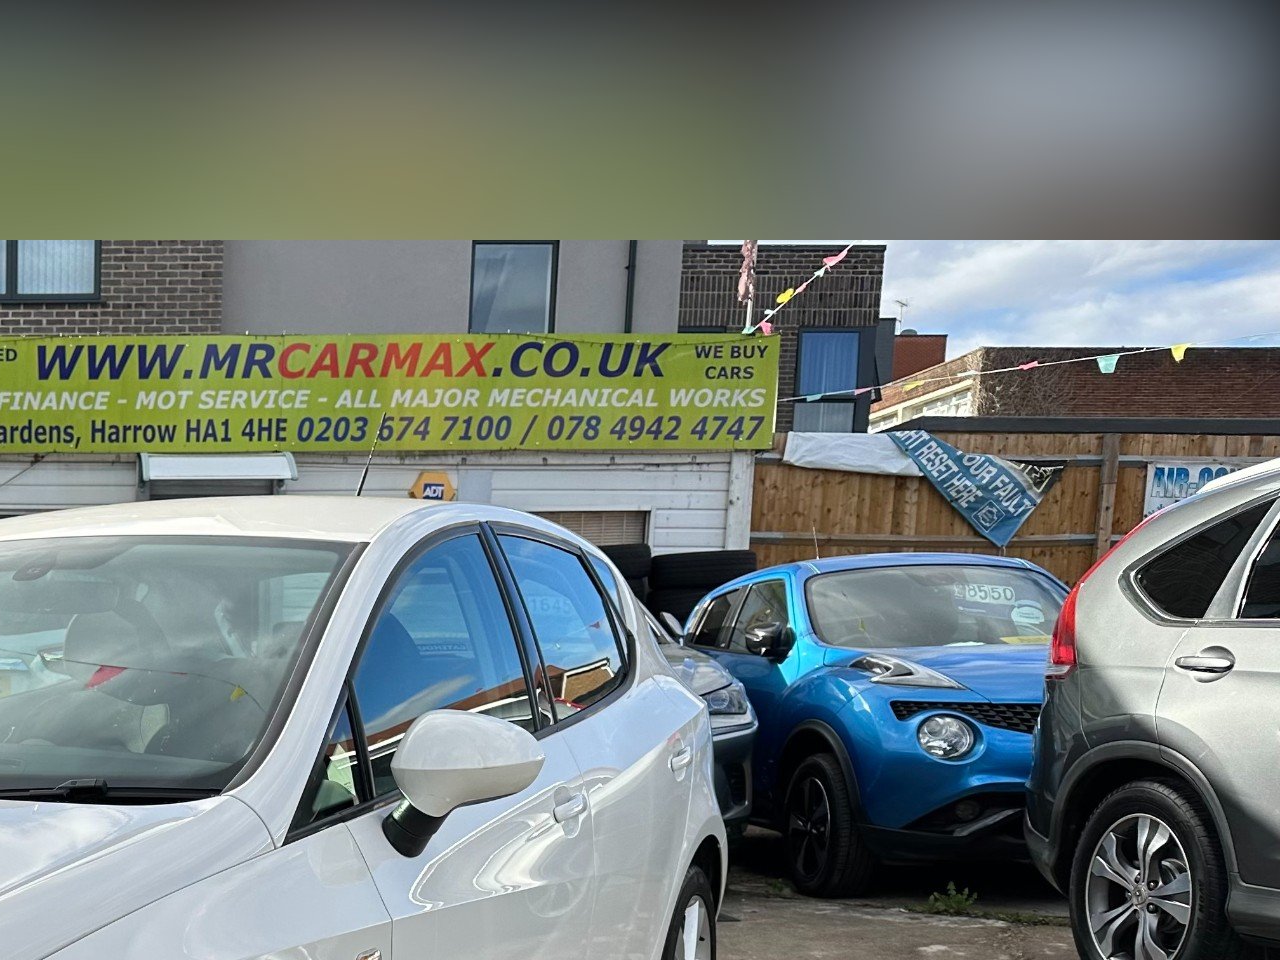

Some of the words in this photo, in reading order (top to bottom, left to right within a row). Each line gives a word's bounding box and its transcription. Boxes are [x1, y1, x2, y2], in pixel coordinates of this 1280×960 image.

[37, 341, 672, 381] WWW.MRCARMAX.CO.UK
[695, 345, 724, 359] WE
[730, 345, 768, 359] BUY
[704, 366, 754, 380] CARS
[135, 390, 194, 410] MOT
[198, 390, 311, 410] SERVICE
[334, 389, 382, 409] ALL
[390, 388, 480, 408] MAJOR
[487, 388, 659, 408] MECHANICAL
[670, 388, 766, 408] WORKS
[91, 418, 178, 444] Harrow
[186, 418, 232, 443] HA1
[241, 418, 288, 443] 4HE
[297, 416, 368, 443] 0203
[378, 416, 431, 442] 674
[440, 415, 512, 442] 7100
[547, 415, 602, 441] 078
[609, 415, 682, 441] 4942
[690, 415, 765, 441] 4747
[914, 440, 959, 481] RESET
[943, 473, 984, 508] HERE
[423, 486, 444, 498] ADT
[988, 473, 1034, 517] FAULT
